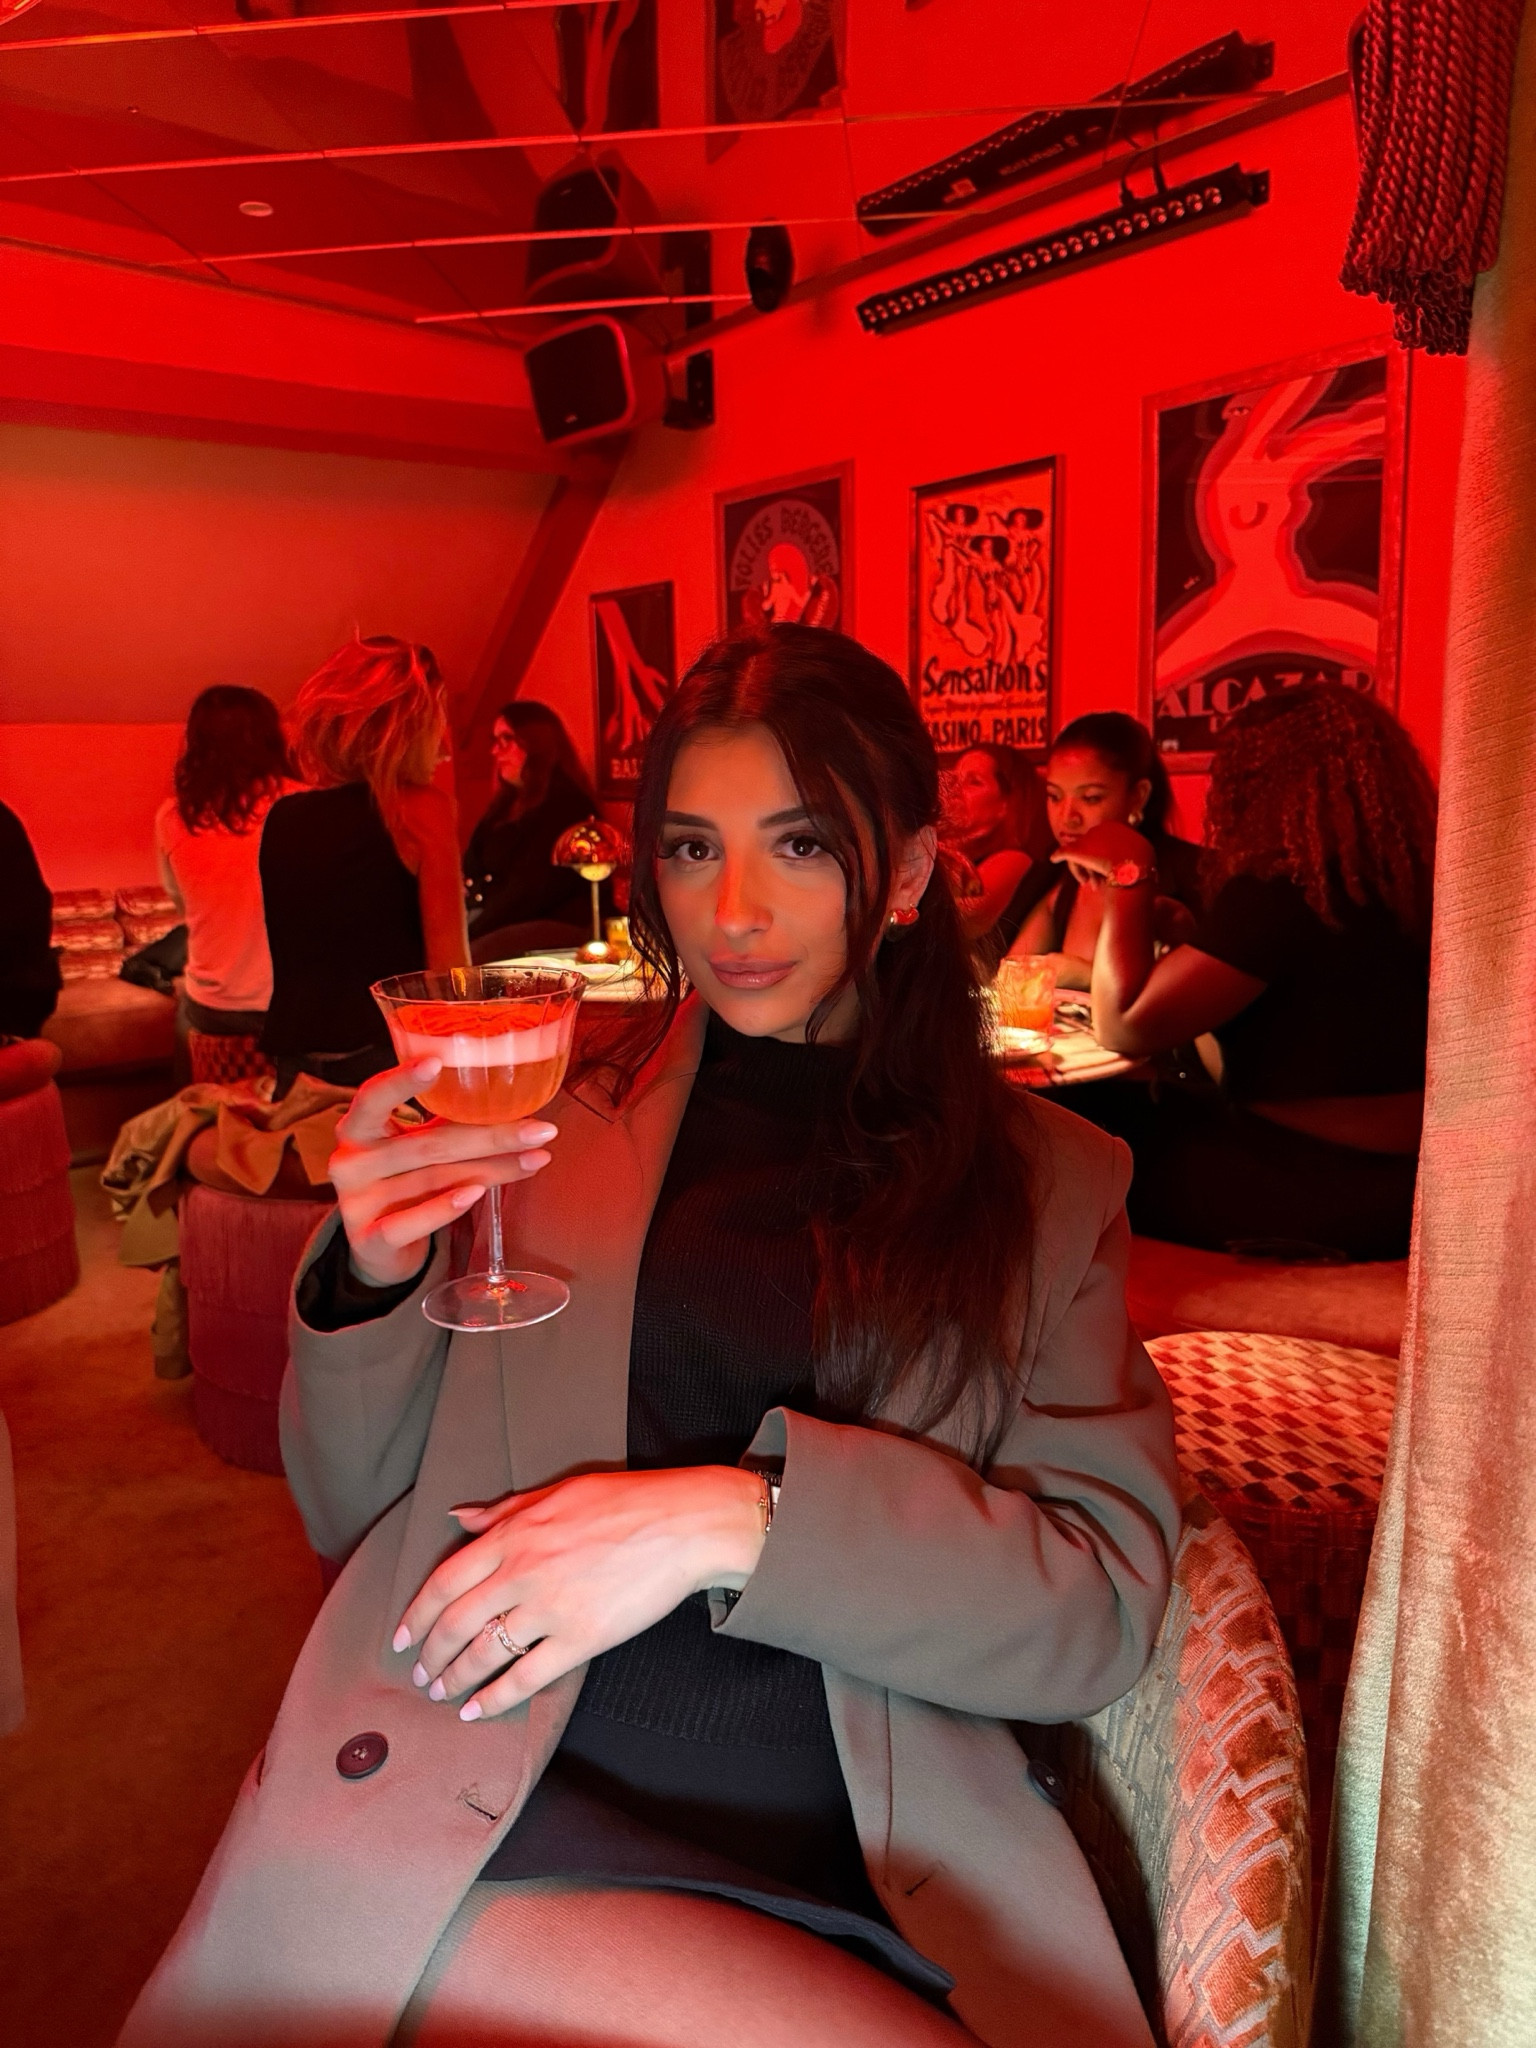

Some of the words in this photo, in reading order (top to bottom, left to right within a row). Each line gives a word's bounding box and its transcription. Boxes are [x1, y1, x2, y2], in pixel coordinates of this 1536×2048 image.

[922, 655, 1047, 697] Sensations
[1157, 669, 1375, 718] ALCAR
[926, 719, 982, 747] ASINO
[993, 716, 1048, 746] PARIS
